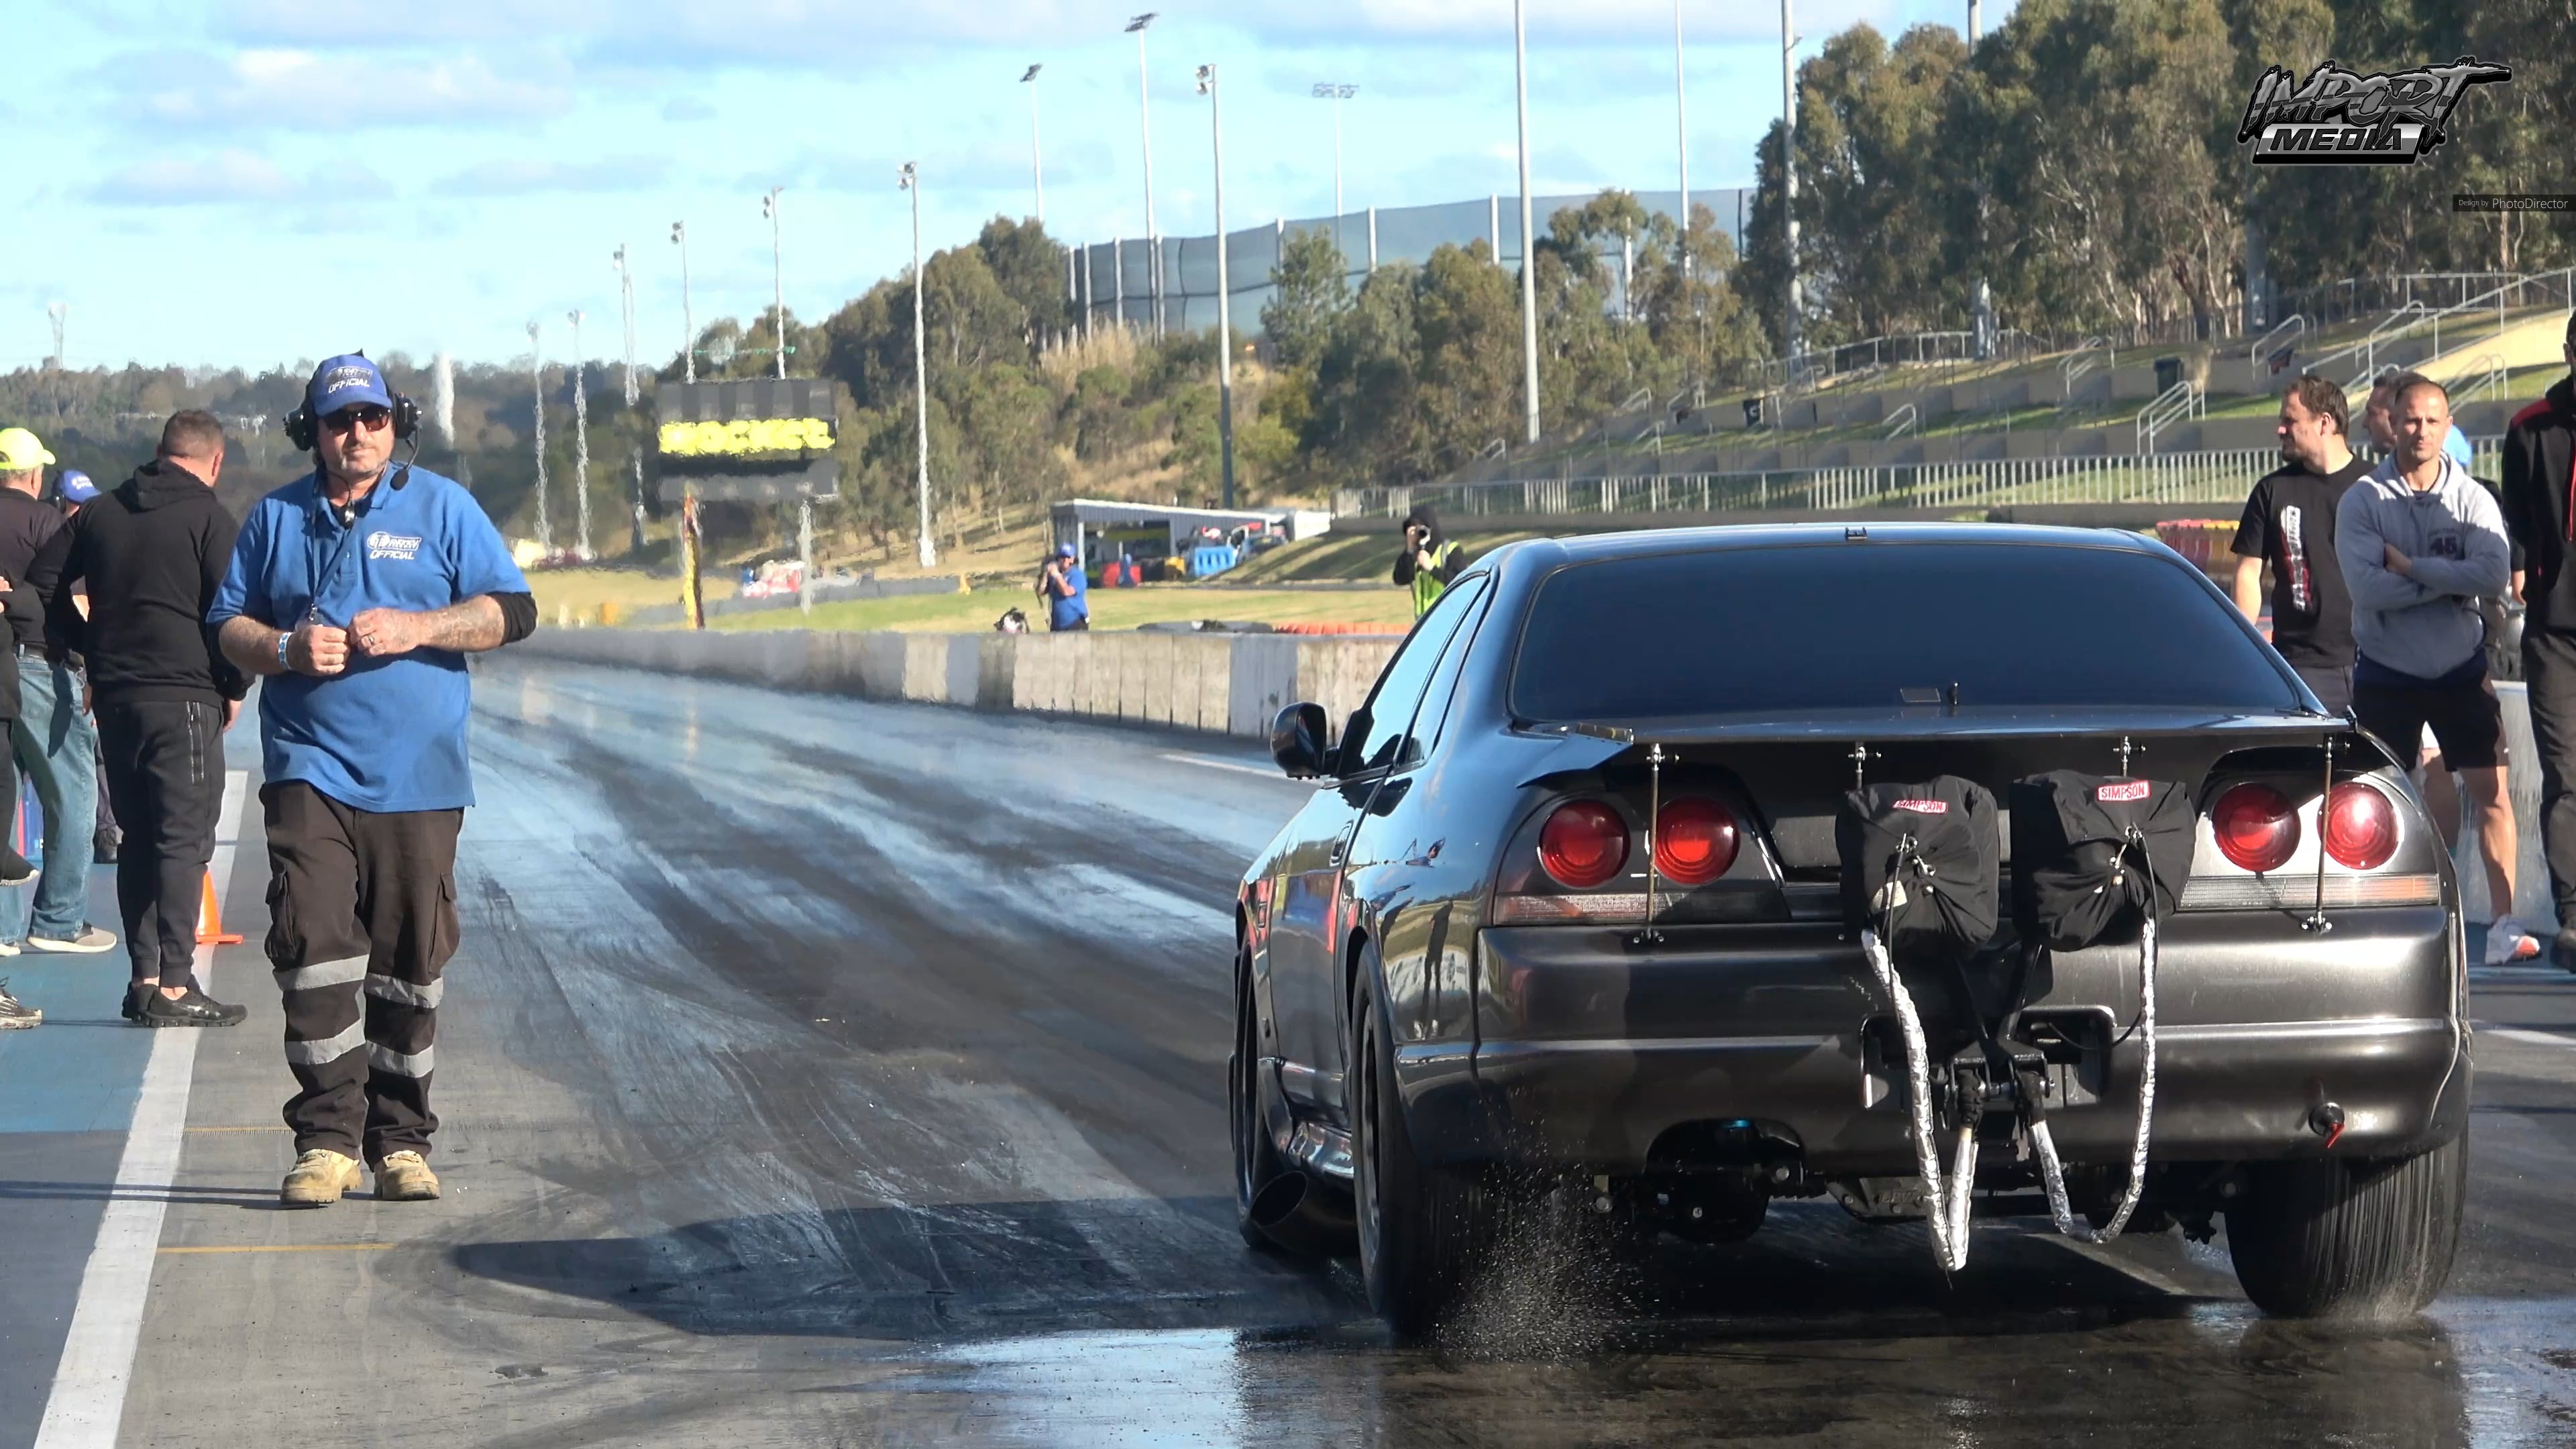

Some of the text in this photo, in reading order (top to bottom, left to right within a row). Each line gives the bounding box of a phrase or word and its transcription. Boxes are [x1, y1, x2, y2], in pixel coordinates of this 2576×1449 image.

[328, 378, 370, 393] OFFICIAL
[370, 550, 415, 560] OFFICIAL
[2100, 782, 2145, 799] SIMPSON
